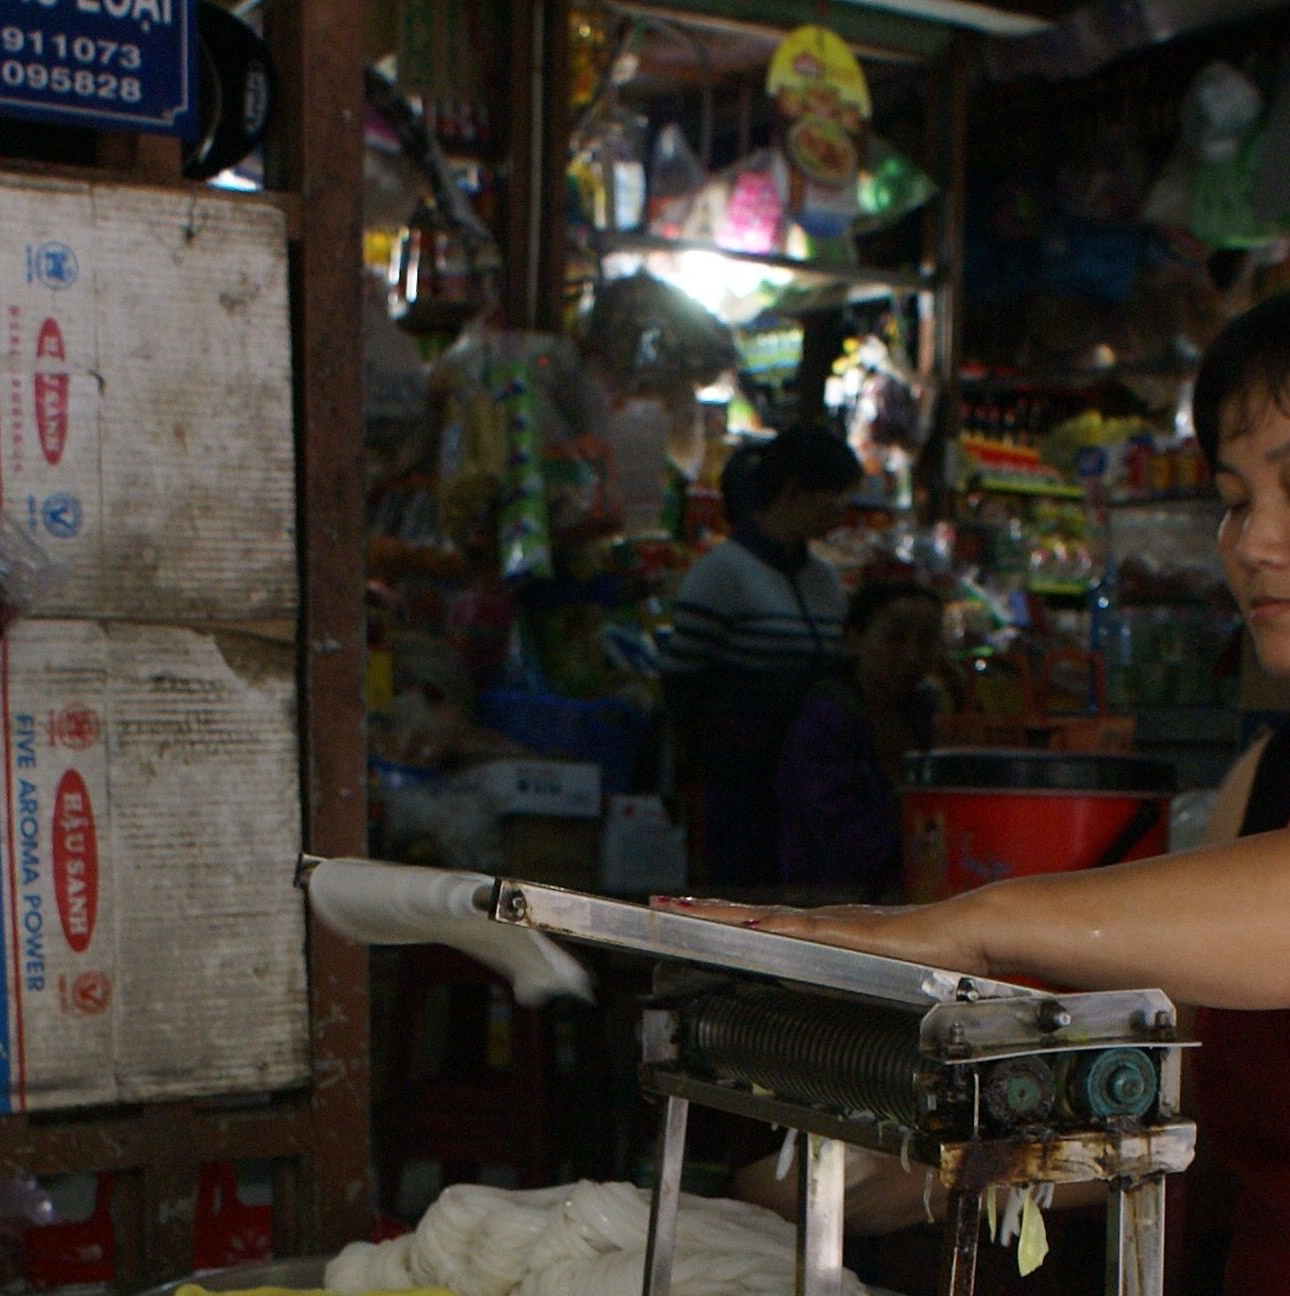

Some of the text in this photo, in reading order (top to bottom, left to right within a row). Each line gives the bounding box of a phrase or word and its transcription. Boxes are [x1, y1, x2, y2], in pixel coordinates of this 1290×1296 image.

[15, 714, 45, 993] FIVE AROMA POWER
[60, 793, 89, 934] HẬU SANH
